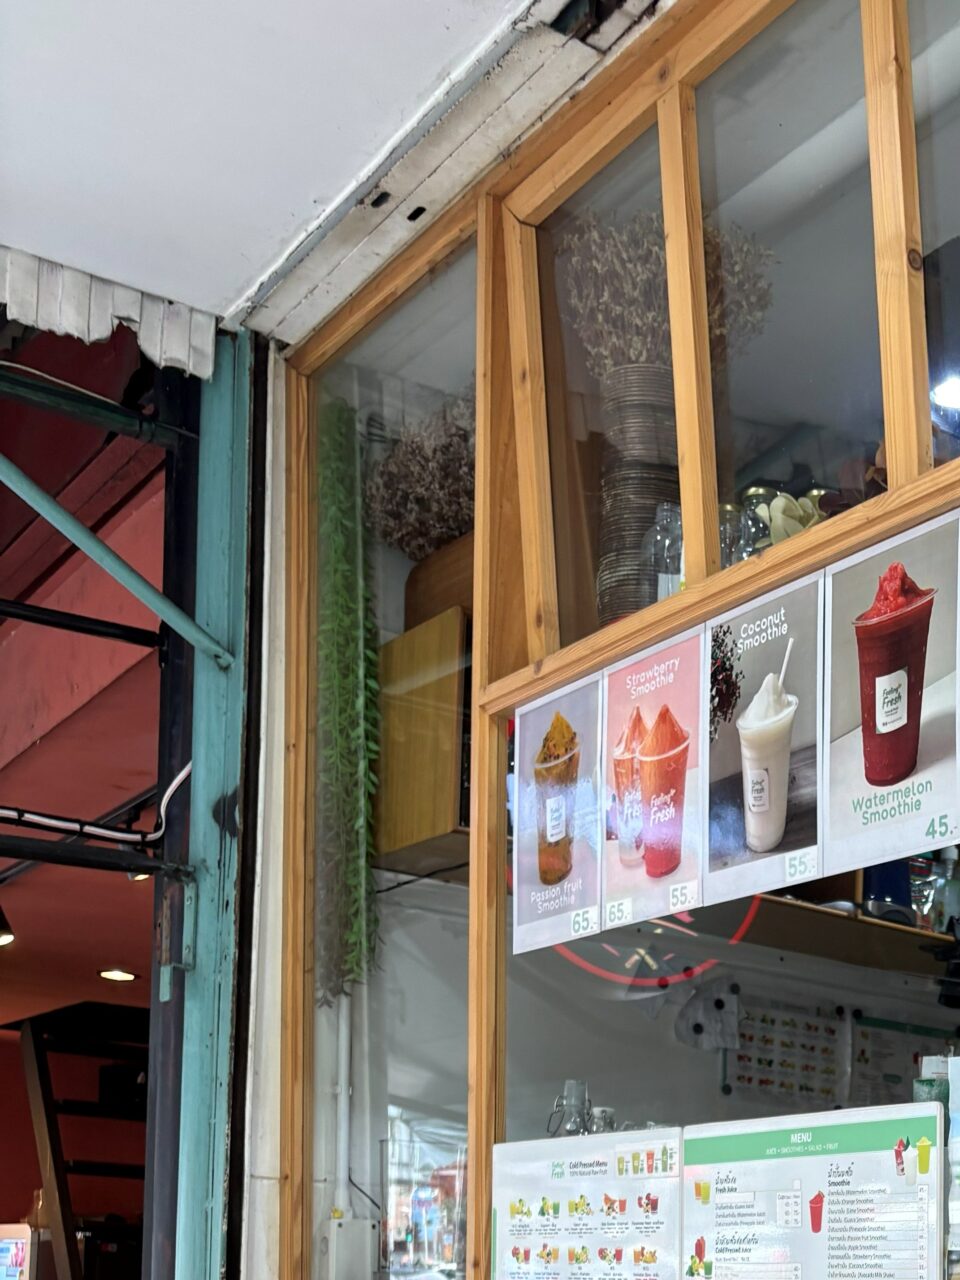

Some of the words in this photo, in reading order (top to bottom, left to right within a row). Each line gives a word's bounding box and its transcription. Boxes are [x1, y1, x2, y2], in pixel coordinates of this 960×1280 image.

[740, 606, 786, 638] Coconut
[737, 622, 788, 653] Smoothie
[626, 657, 680, 689] Strawberry
[630, 673, 674, 700] Smoothie
[882, 694, 902, 710] Fresh
[852, 778, 933, 813] Watermelon
[650, 801, 676, 828] Fresh
[862, 797, 922, 826] Smoothie
[530, 885, 561, 904] Passion
[562, 878, 583, 895] fruit
[537, 893, 575, 914] Smoothie
[790, 1132, 812, 1144] MENU
[569, 1161, 578, 1169] Cold
[580, 1160, 595, 1168] Pressed
[828, 1179, 851, 1187] Smoothie
